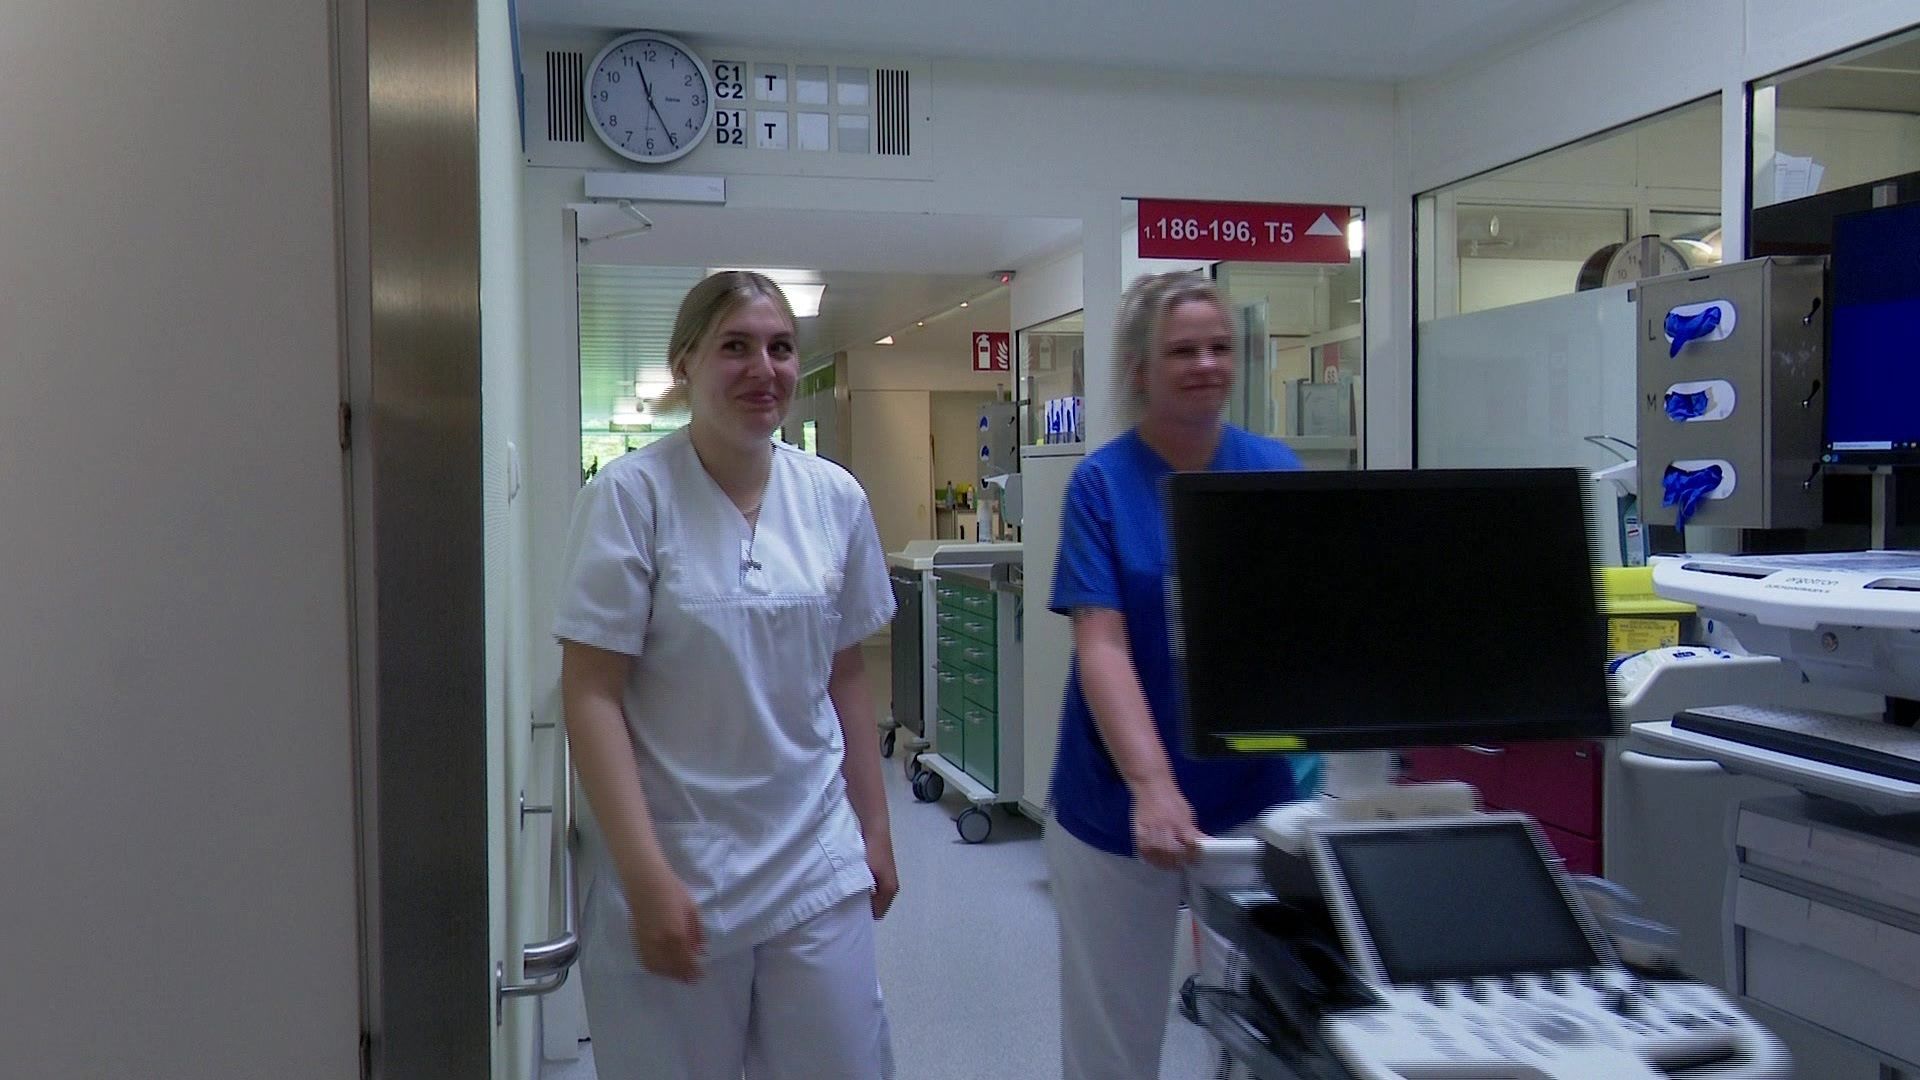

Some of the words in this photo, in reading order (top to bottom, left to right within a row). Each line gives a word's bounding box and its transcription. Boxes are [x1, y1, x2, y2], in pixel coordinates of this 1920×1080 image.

[623, 56, 634, 67] 11
[643, 50, 657, 62] 12
[670, 58, 675, 69] 1
[607, 71, 621, 84] 10
[715, 64, 739, 82] C1
[684, 75, 692, 87] 2
[764, 74, 777, 91] T
[600, 90, 609, 102] 9
[715, 82, 743, 99] C2
[691, 95, 700, 106] 3
[609, 115, 618, 127] 8
[685, 118, 693, 130] 4
[716, 111, 739, 128] D1
[625, 131, 633, 142] 7
[716, 128, 743, 145] D2
[764, 123, 777, 139] T
[646, 138, 654, 150] 6
[669, 132, 678, 145] 5
[1264, 221, 1294, 243] T5
[1648, 319, 1657, 341] L
[1647, 393, 1657, 412] M
